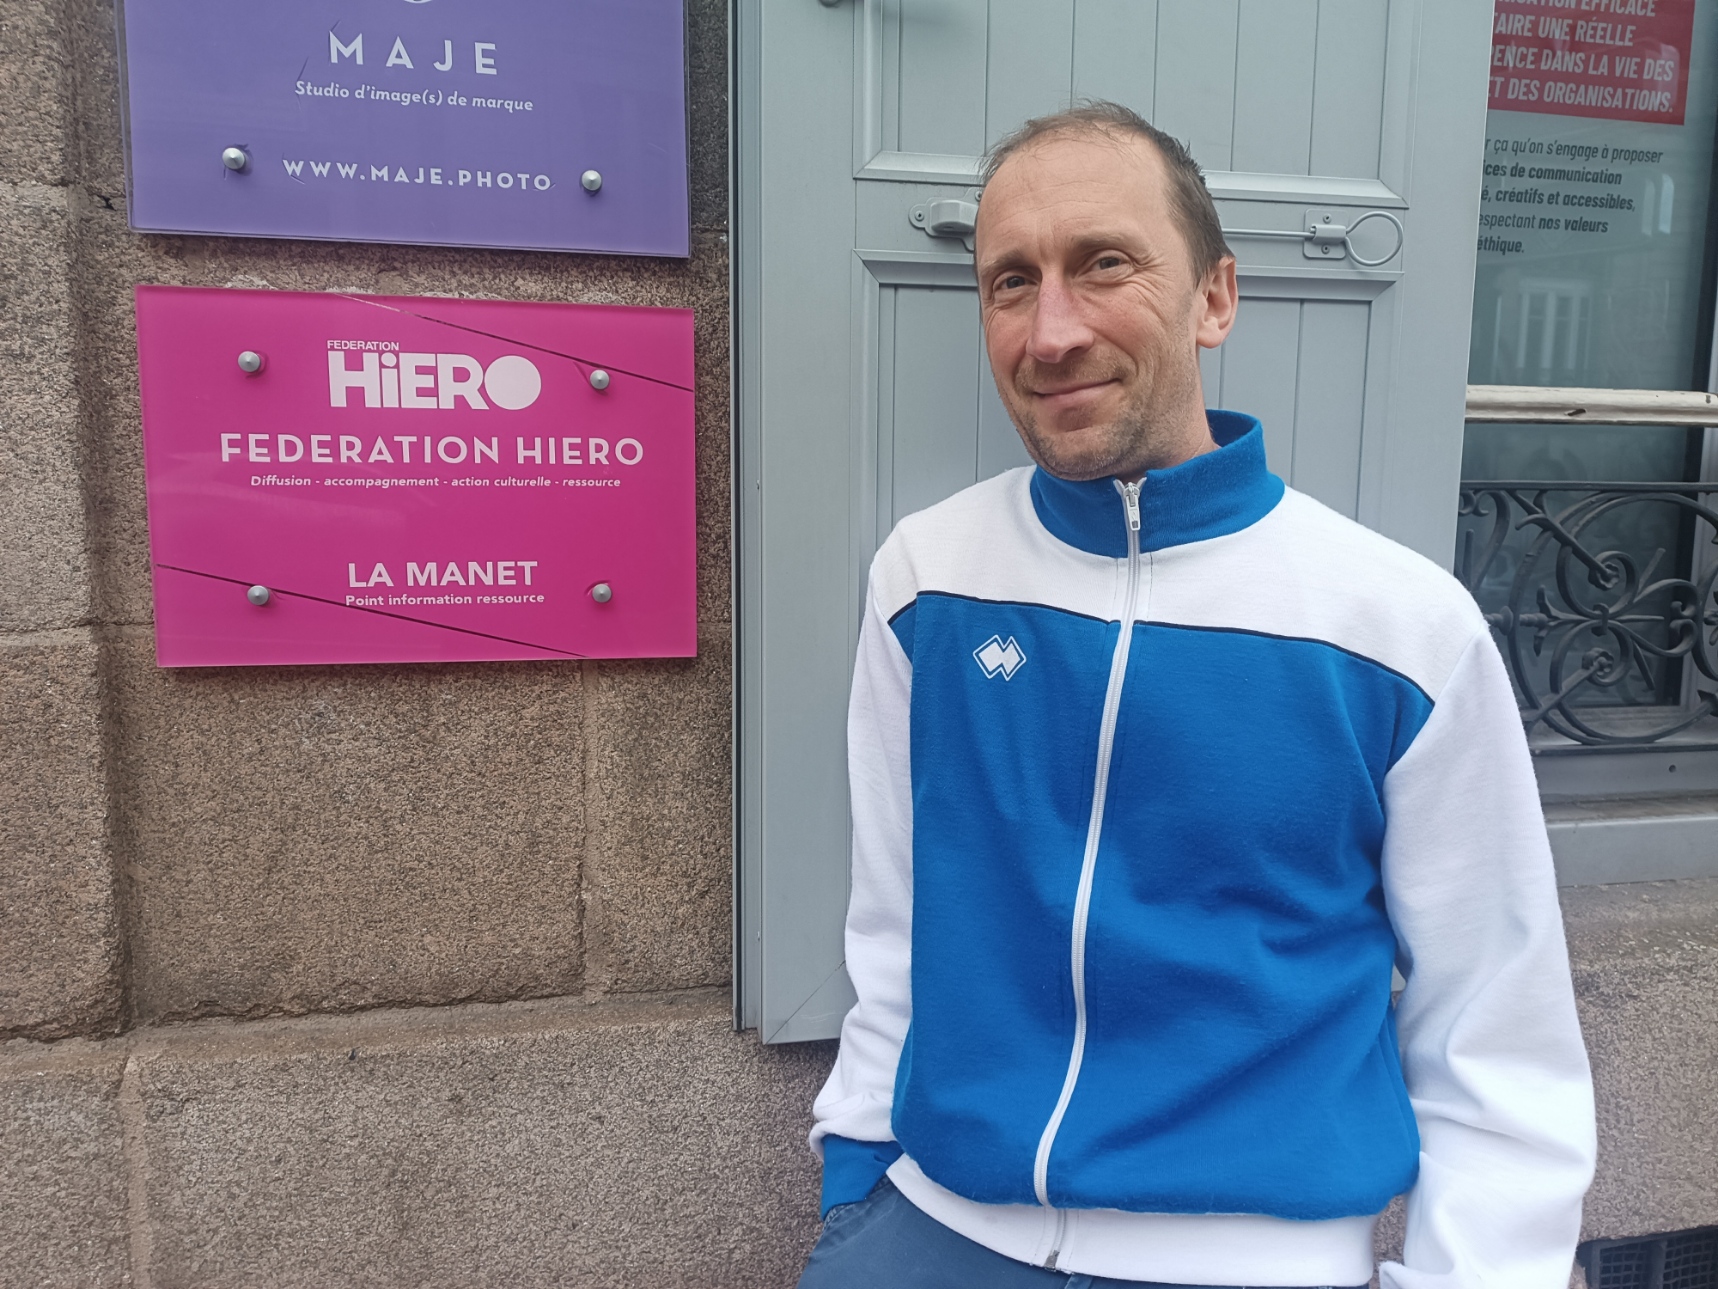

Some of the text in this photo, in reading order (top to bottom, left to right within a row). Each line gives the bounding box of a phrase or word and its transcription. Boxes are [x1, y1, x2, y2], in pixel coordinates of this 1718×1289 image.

[1538, 16, 1573, 40] UNE
[1575, 16, 1636, 47] RÉELLE
[329, 30, 498, 75] MAJE
[1540, 49, 1586, 73] DANS
[1588, 53, 1609, 76] LA
[1615, 56, 1641, 79] VIE
[1642, 58, 1675, 81] DES
[294, 80, 534, 114] Studio d'image(s) de marque
[1507, 78, 1541, 101] DES
[1543, 81, 1674, 113] ORGANISATIONS.
[1493, 139, 1509, 155] ça
[1601, 144, 1609, 159] à
[1610, 147, 1664, 165] proposer
[282, 159, 551, 191] WWW.MAJE.PHOTO
[1510, 162, 1526, 178] de
[1528, 166, 1622, 185] communication
[1495, 187, 1545, 205] créatifs
[1547, 191, 1561, 206] et
[1562, 193, 1636, 213] accessibles,
[1538, 217, 1560, 230] nos
[1564, 216, 1609, 233] valeurs
[326, 339, 400, 351] FEDERATION
[220, 432, 644, 466] FEDERATION HIERO
[250, 474, 312, 486] Diffusion
[323, 477, 440, 489] accompagnement
[451, 476, 490, 487] action
[493, 475, 552, 487] culturelle
[562, 479, 621, 487] ressource
[348, 560, 538, 588] LA MANET
[345, 593, 545, 606] Point information ressource
